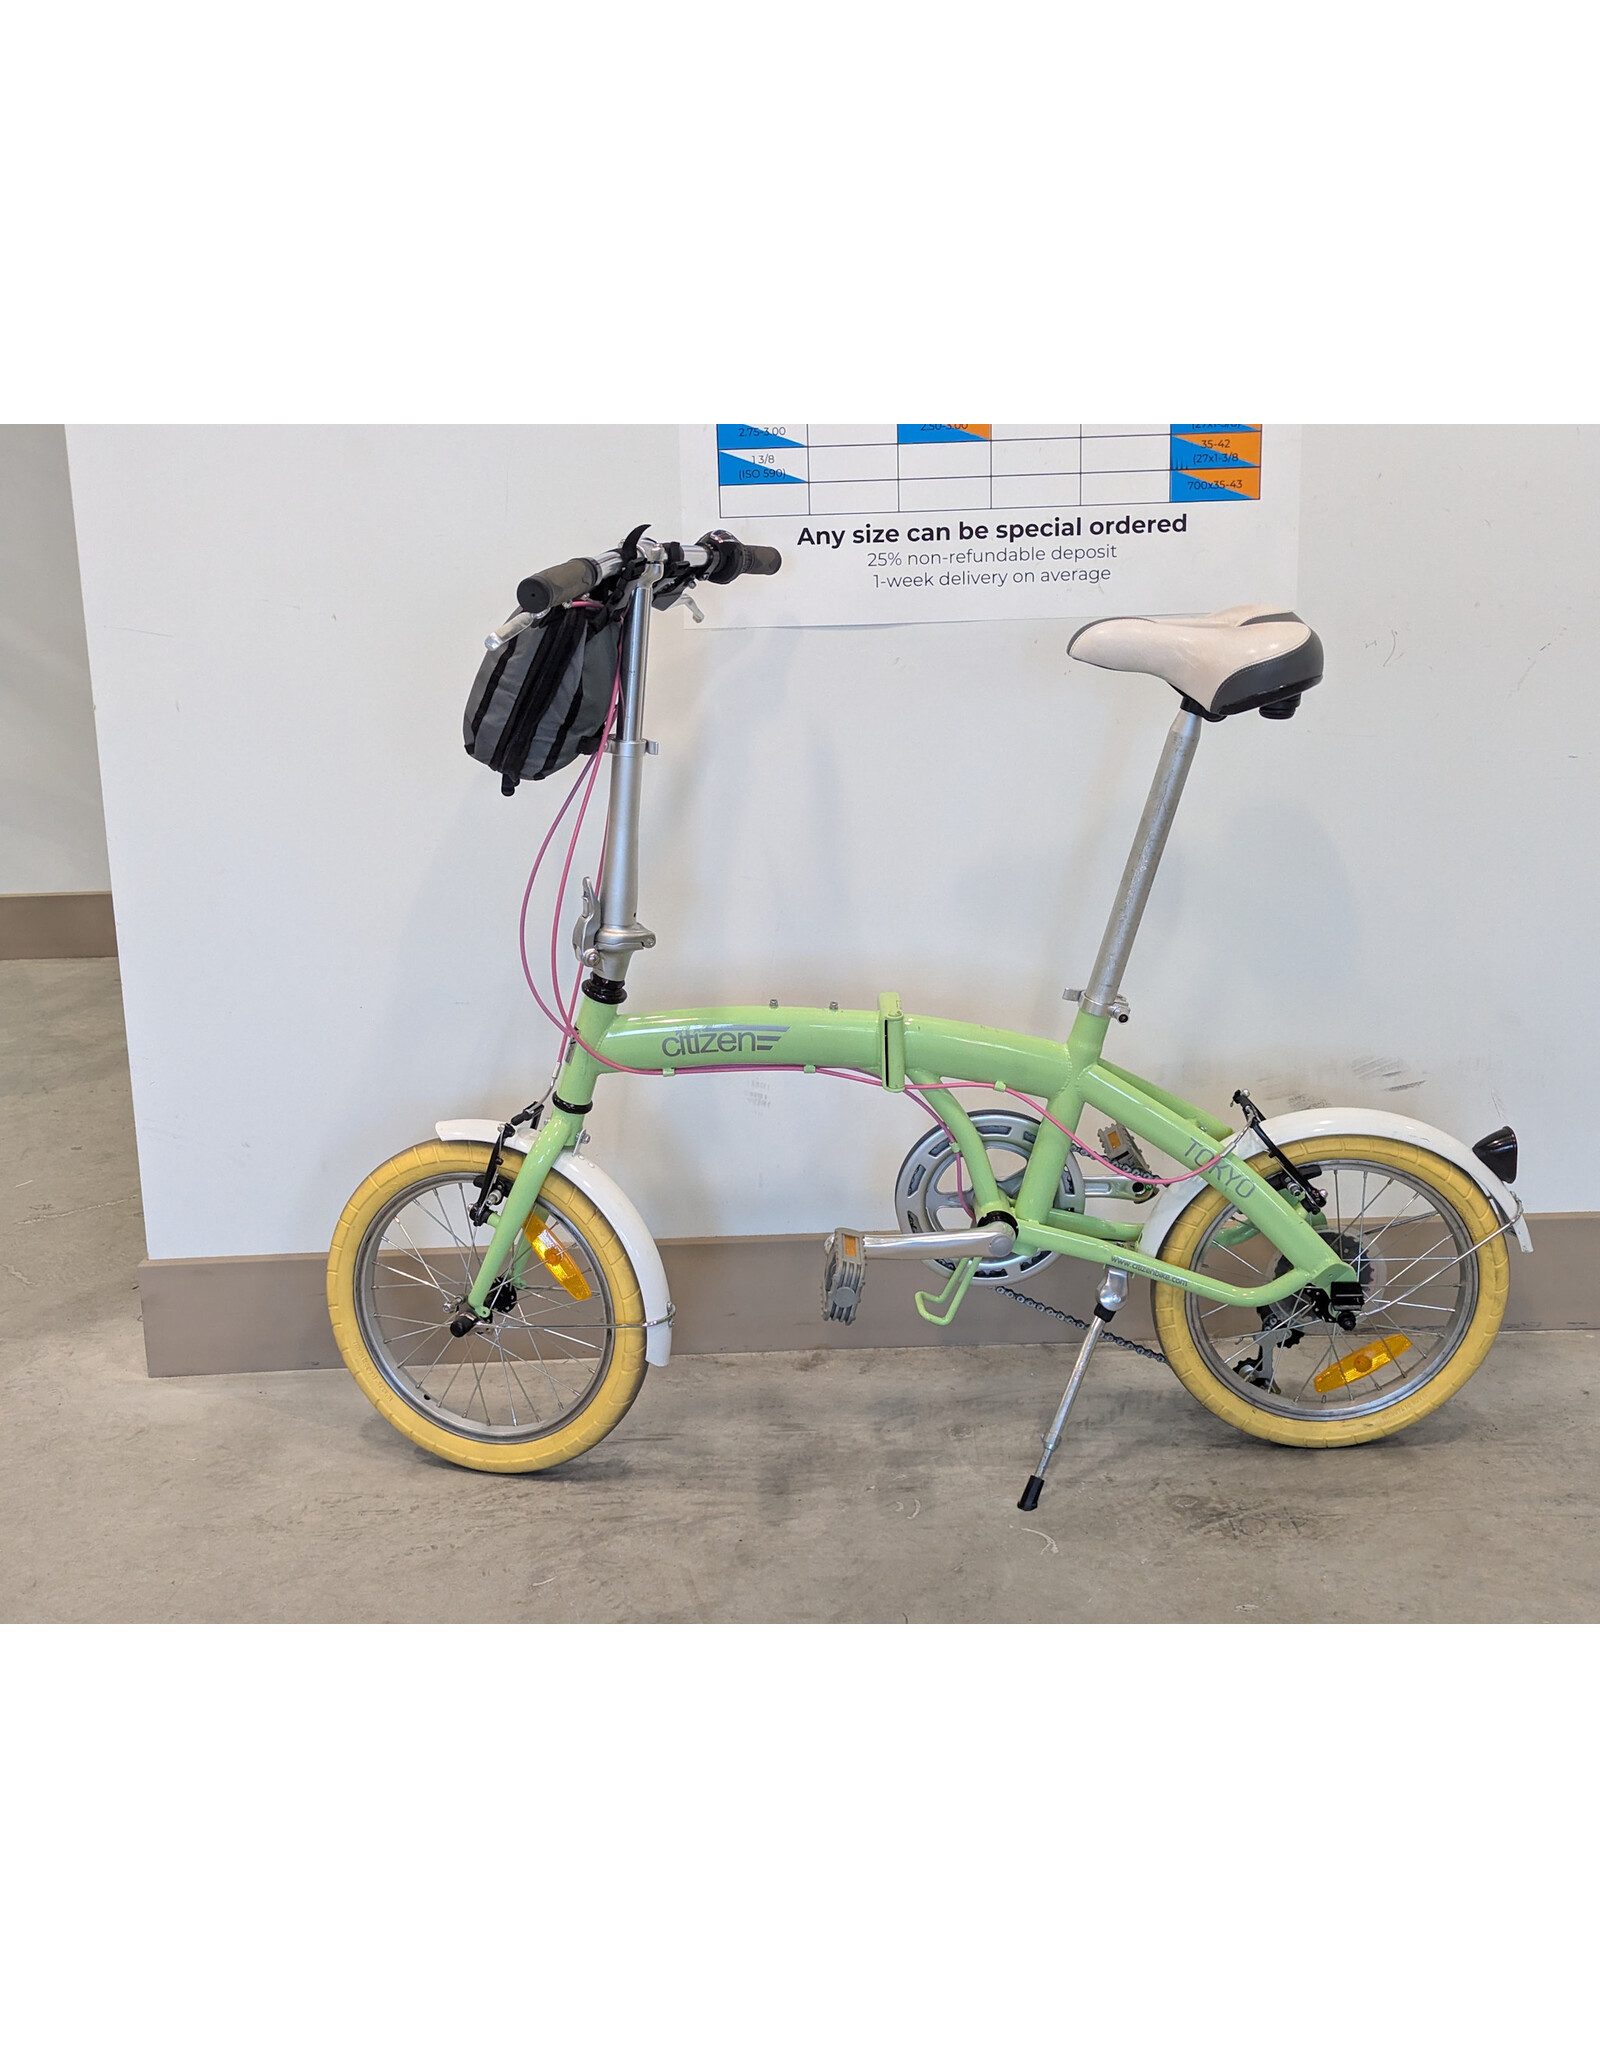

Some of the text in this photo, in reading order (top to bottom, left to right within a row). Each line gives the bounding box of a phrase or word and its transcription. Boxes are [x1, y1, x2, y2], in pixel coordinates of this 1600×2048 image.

[738, 426, 787, 437] 2.75-3.00
[1200, 439, 1231, 449] 35-42
[738, 468, 786, 481] (ISO 590)
[1187, 479, 1243, 491] 700x35-43
[796, 513, 1188, 550] Any size can be special ordered
[867, 543, 1118, 567] 25% non-refundable deposit
[873, 567, 1112, 588] 1-week delivery on average
[661, 1026, 757, 1058] citizen
[1184, 1137, 1256, 1199] TOKYO
